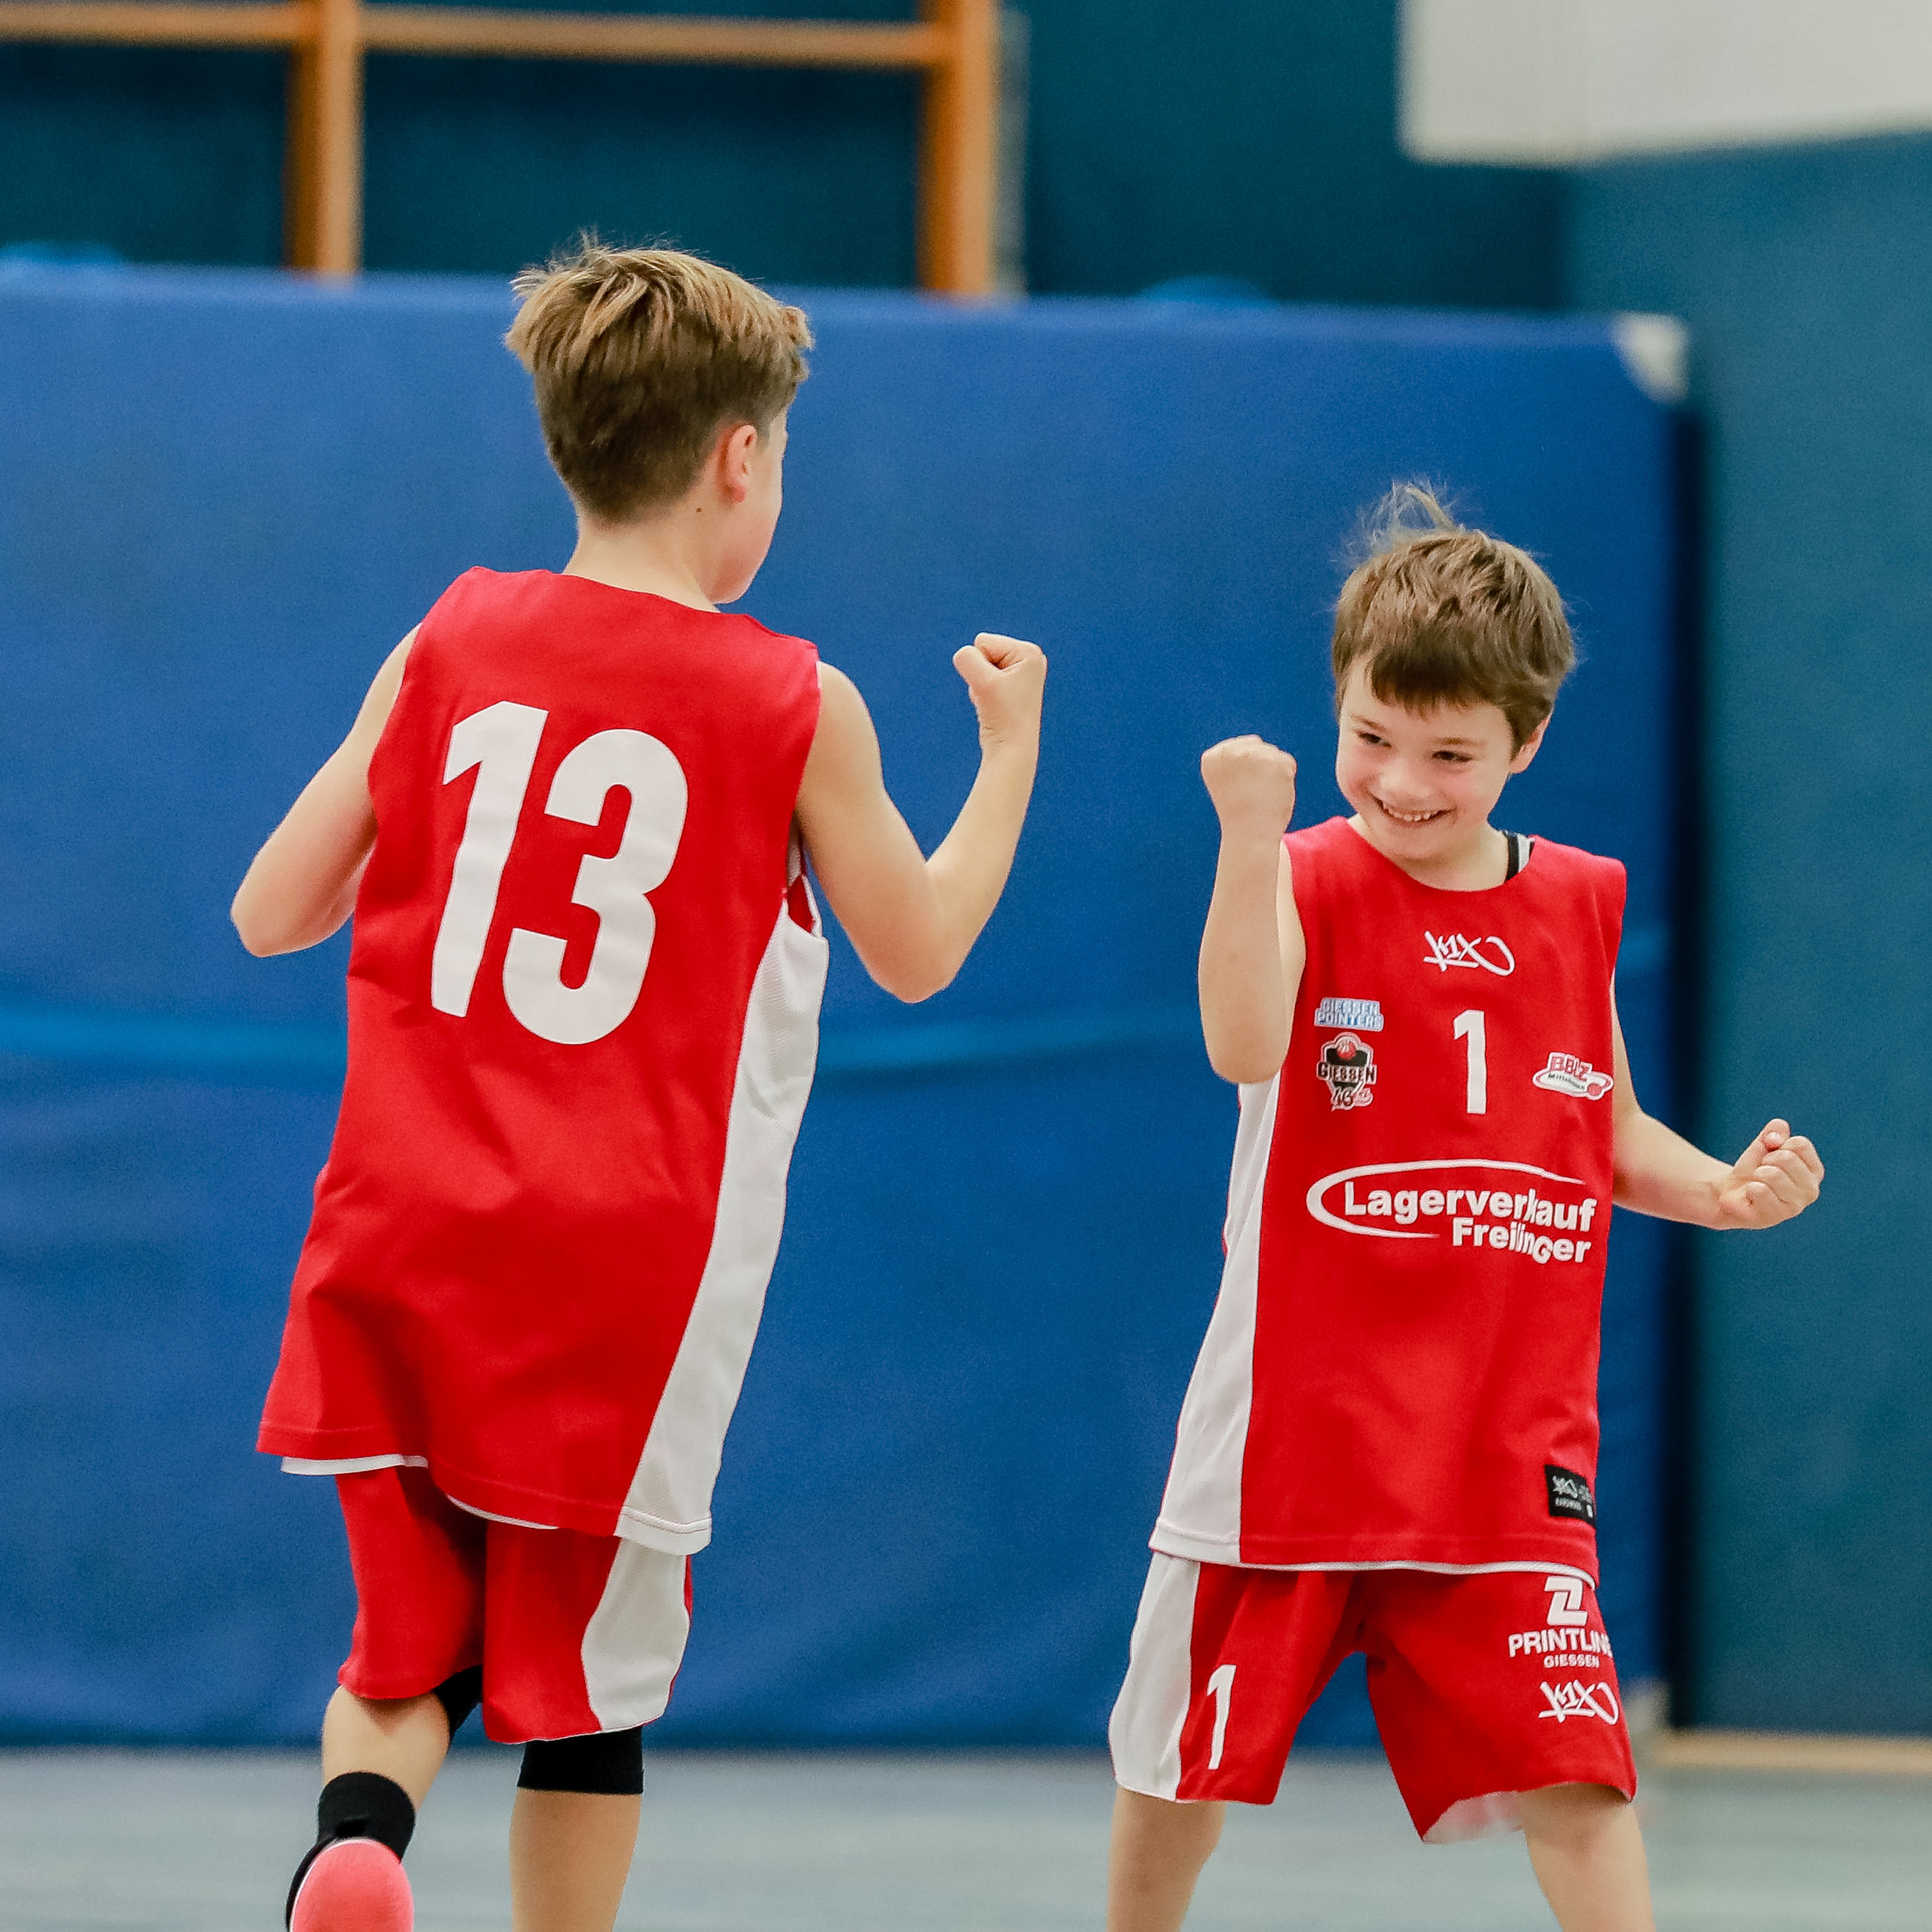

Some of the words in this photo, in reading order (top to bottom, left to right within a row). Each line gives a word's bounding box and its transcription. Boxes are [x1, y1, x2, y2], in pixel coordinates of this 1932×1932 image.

[431, 700, 689, 1045] 13
[1454, 1009, 1487, 1115] 1
[1344, 1181, 1598, 1232] Lagerverkauf
[1452, 1217, 1592, 1264] Freilinger
[1543, 1654, 1601, 1669] GIESSEN
[1207, 1664, 1238, 1770] 1
